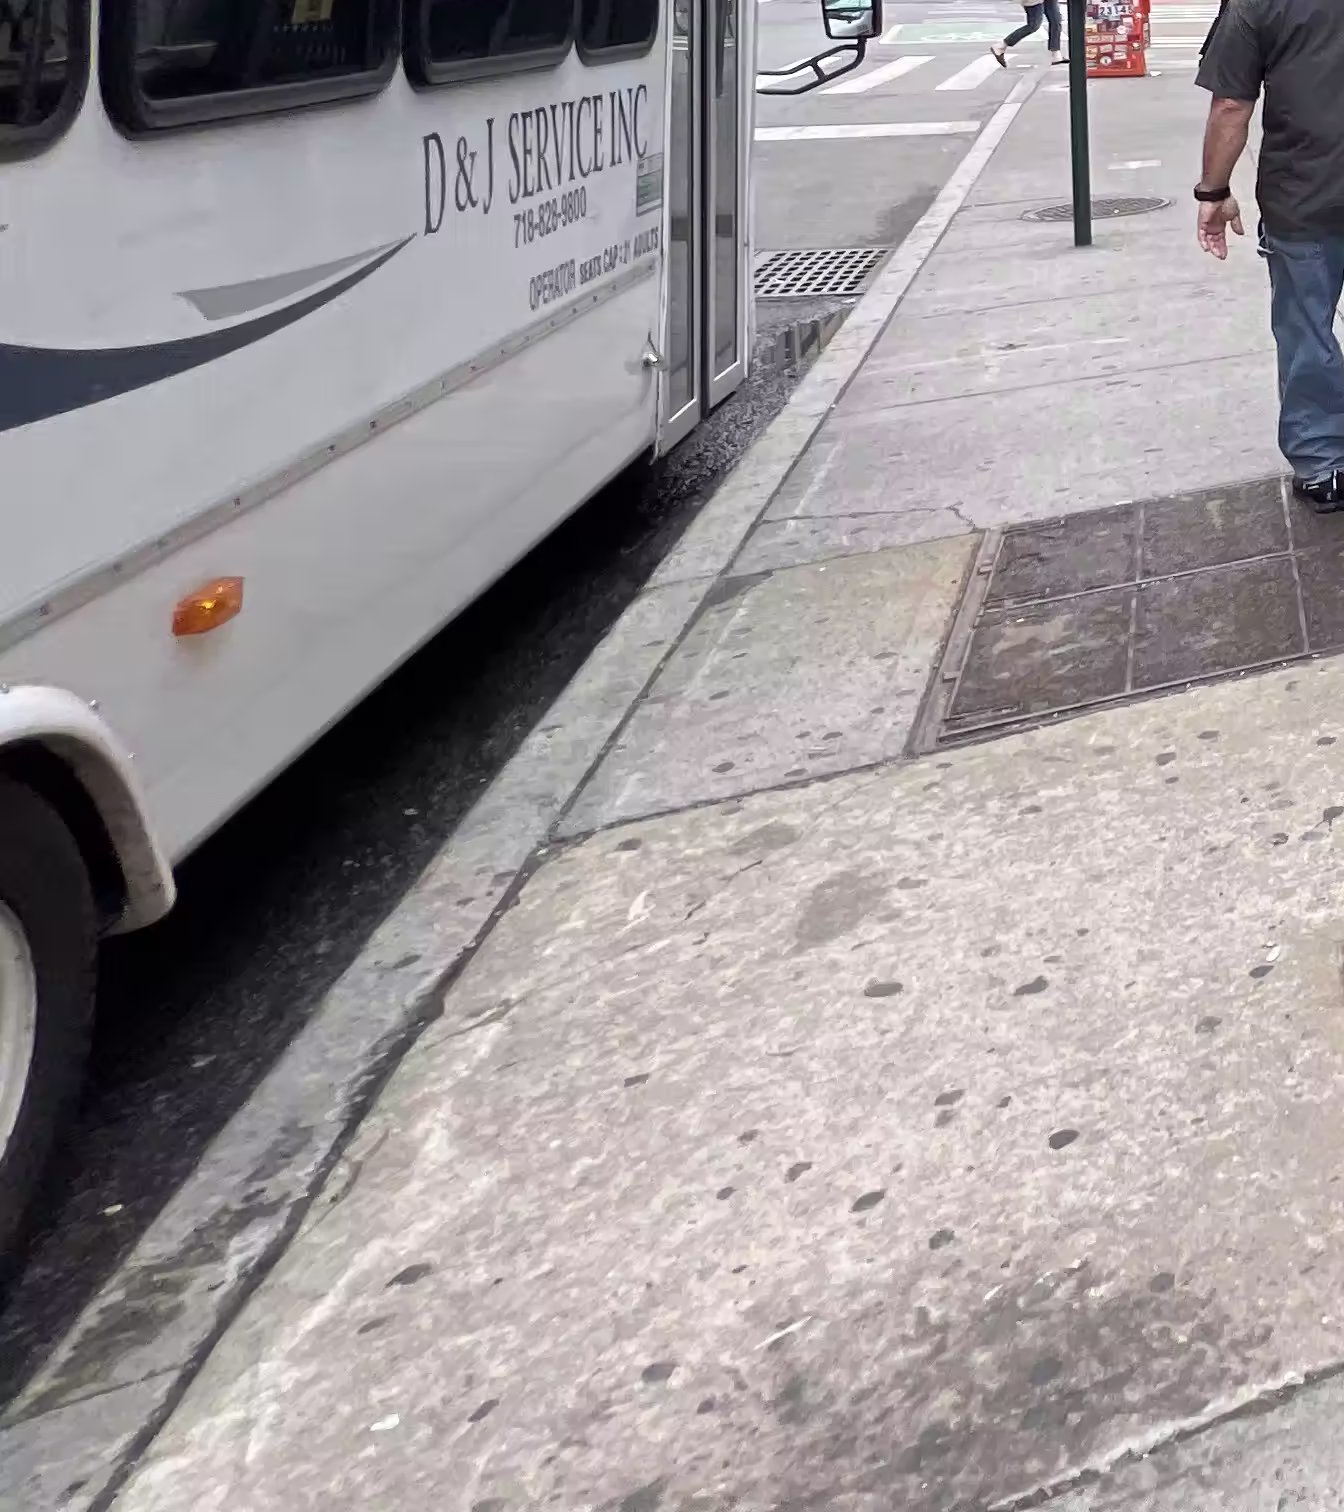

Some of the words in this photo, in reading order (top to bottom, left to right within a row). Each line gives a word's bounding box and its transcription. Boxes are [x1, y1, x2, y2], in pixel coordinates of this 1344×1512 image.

[422, 132, 446, 236] D
[454, 136, 479, 212] &
[482, 117, 495, 214] J
[508, 94, 604, 204] SERVICE
[608, 84, 648, 167] INC
[512, 185, 588, 248] 718-828-9800
[529, 259, 576, 310] OPERATOR
[579, 255, 602, 285] SEATS
